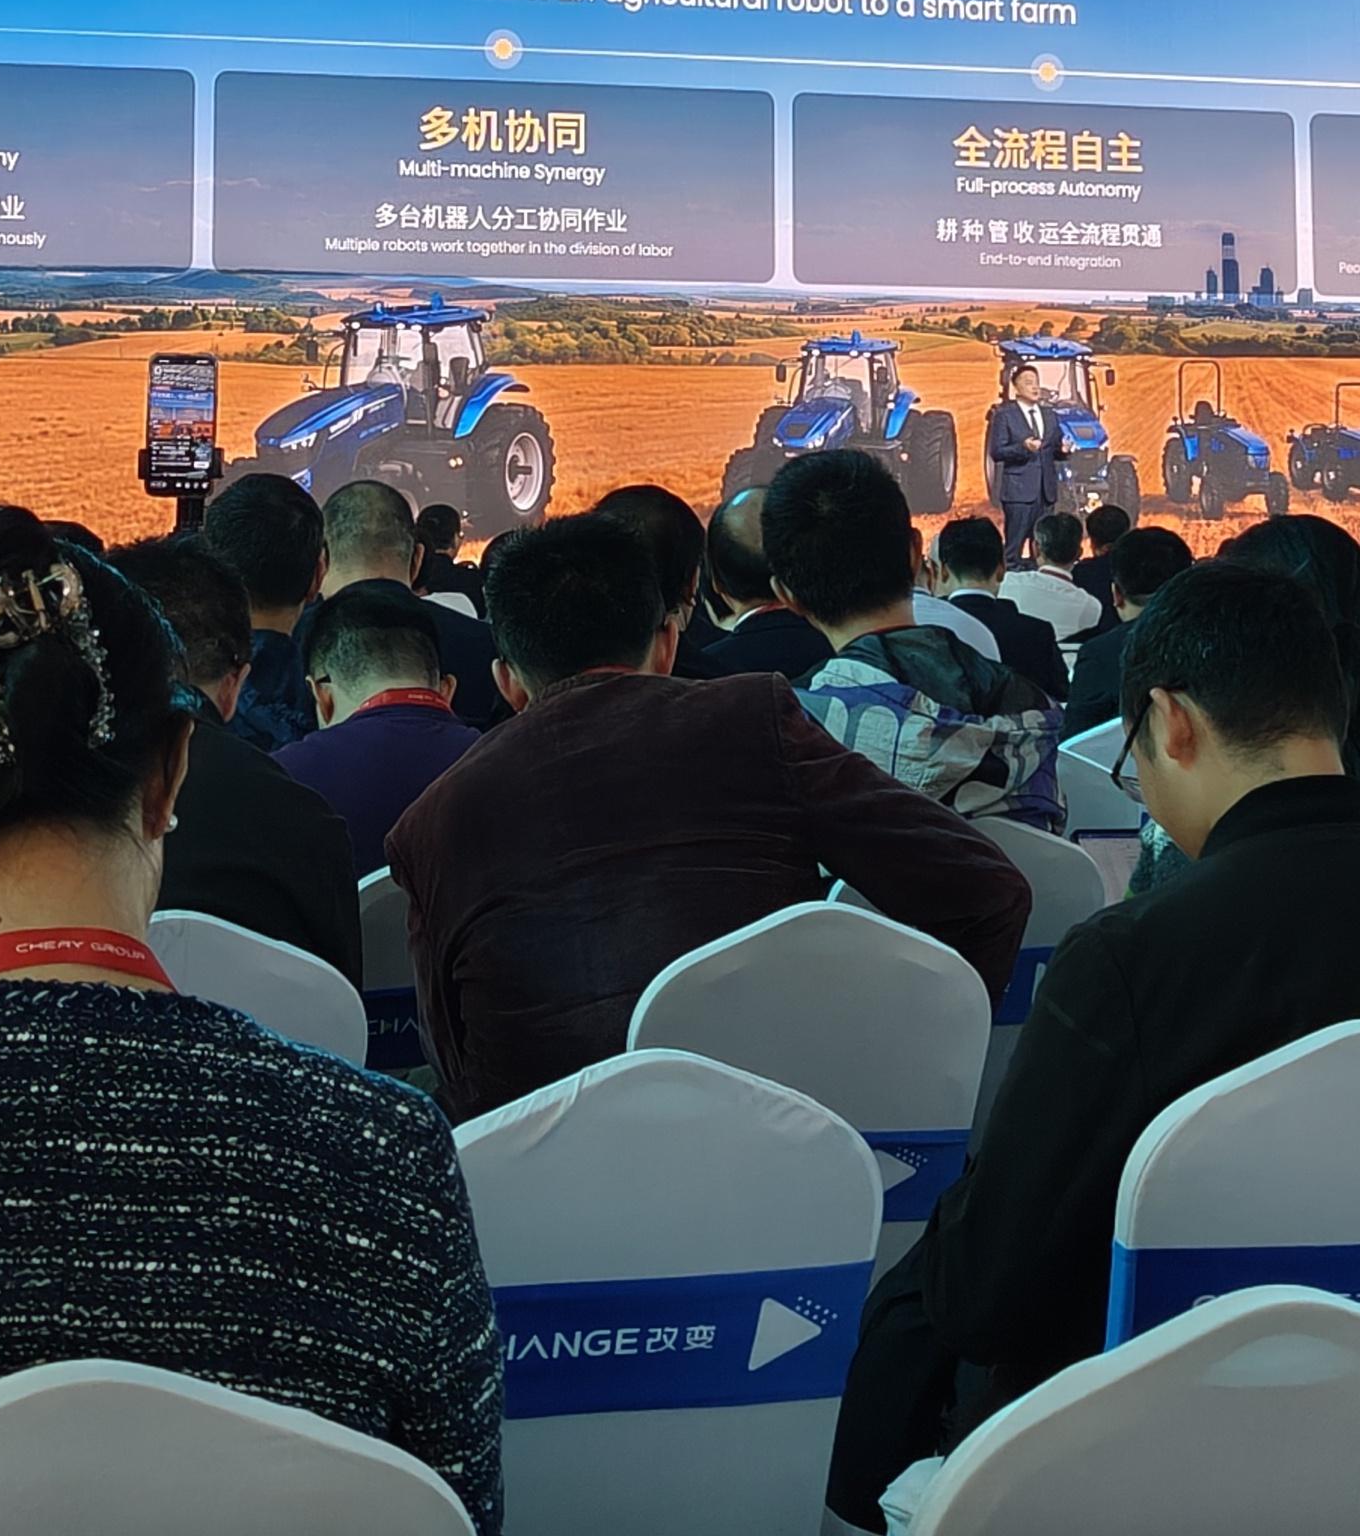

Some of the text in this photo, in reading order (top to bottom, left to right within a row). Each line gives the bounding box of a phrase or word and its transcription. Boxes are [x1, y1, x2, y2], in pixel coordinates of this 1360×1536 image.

[418, 106, 586, 155] 多机协同
[952, 125, 1143, 173] 全流程自主
[399, 160, 605, 186] Multi-machine Synergy
[957, 177, 1140, 202] Full-process Autonomy
[375, 203, 627, 232] 多台机器人分工协同作业
[325, 237, 673, 257] Multiple robots work together in the division of labor
[980, 252, 1121, 271] End-to-end integration
